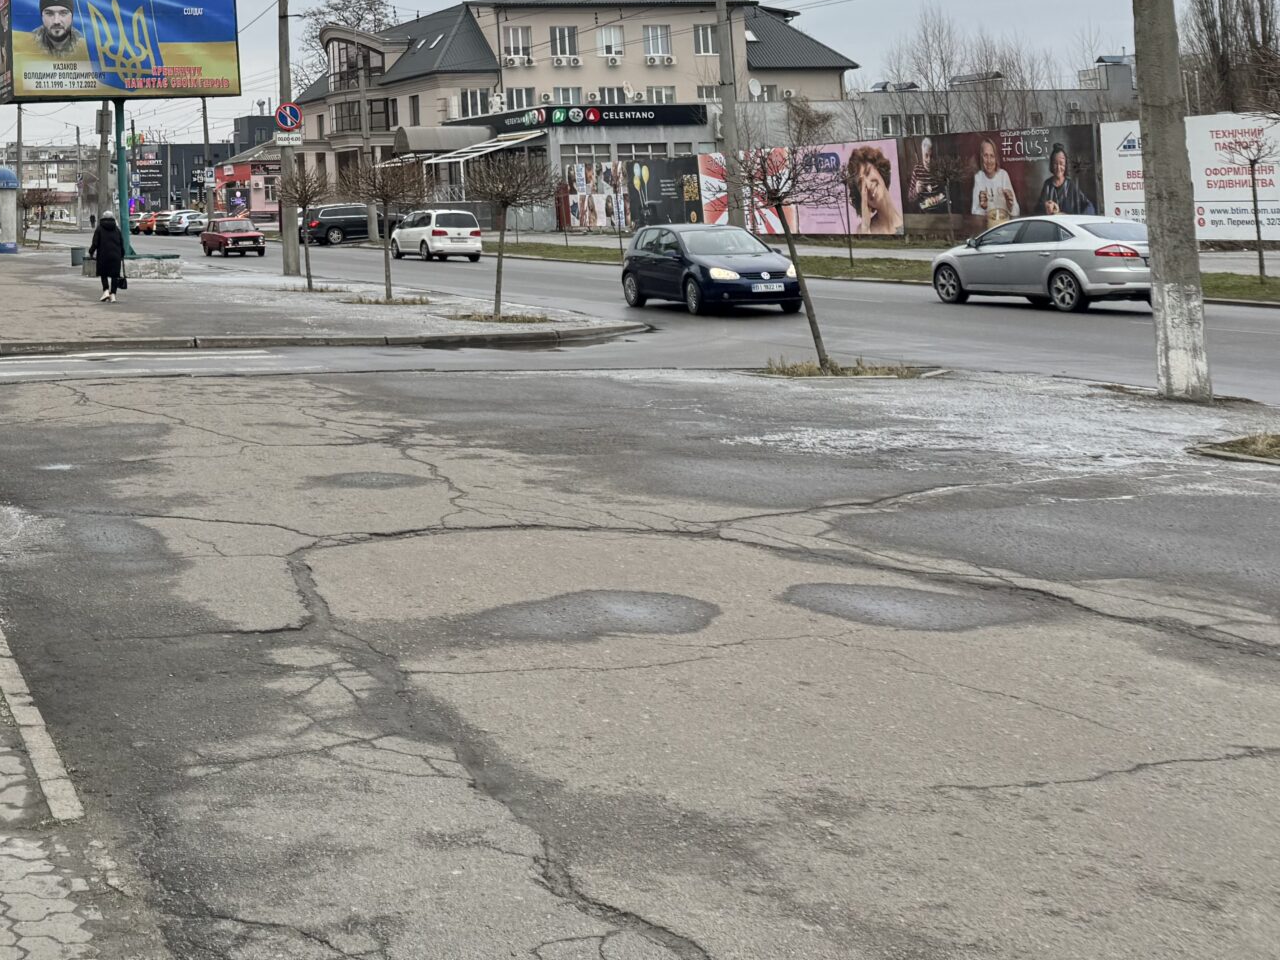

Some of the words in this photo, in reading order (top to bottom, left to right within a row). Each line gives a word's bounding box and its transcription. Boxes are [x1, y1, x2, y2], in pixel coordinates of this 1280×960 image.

[52, 62, 78, 71] КАЗАКОВ
[23, 71, 58, 80] ВОЛОДИМИР
[58, 71, 106, 80] ВОЛОДИМИРОВИЧ
[602, 111, 655, 120] CELENTANO
[1204, 165, 1275, 176] ОФОРМЛЕННЯ
[1115, 182, 1120, 191] В
[1210, 219, 1225, 227] вул.
